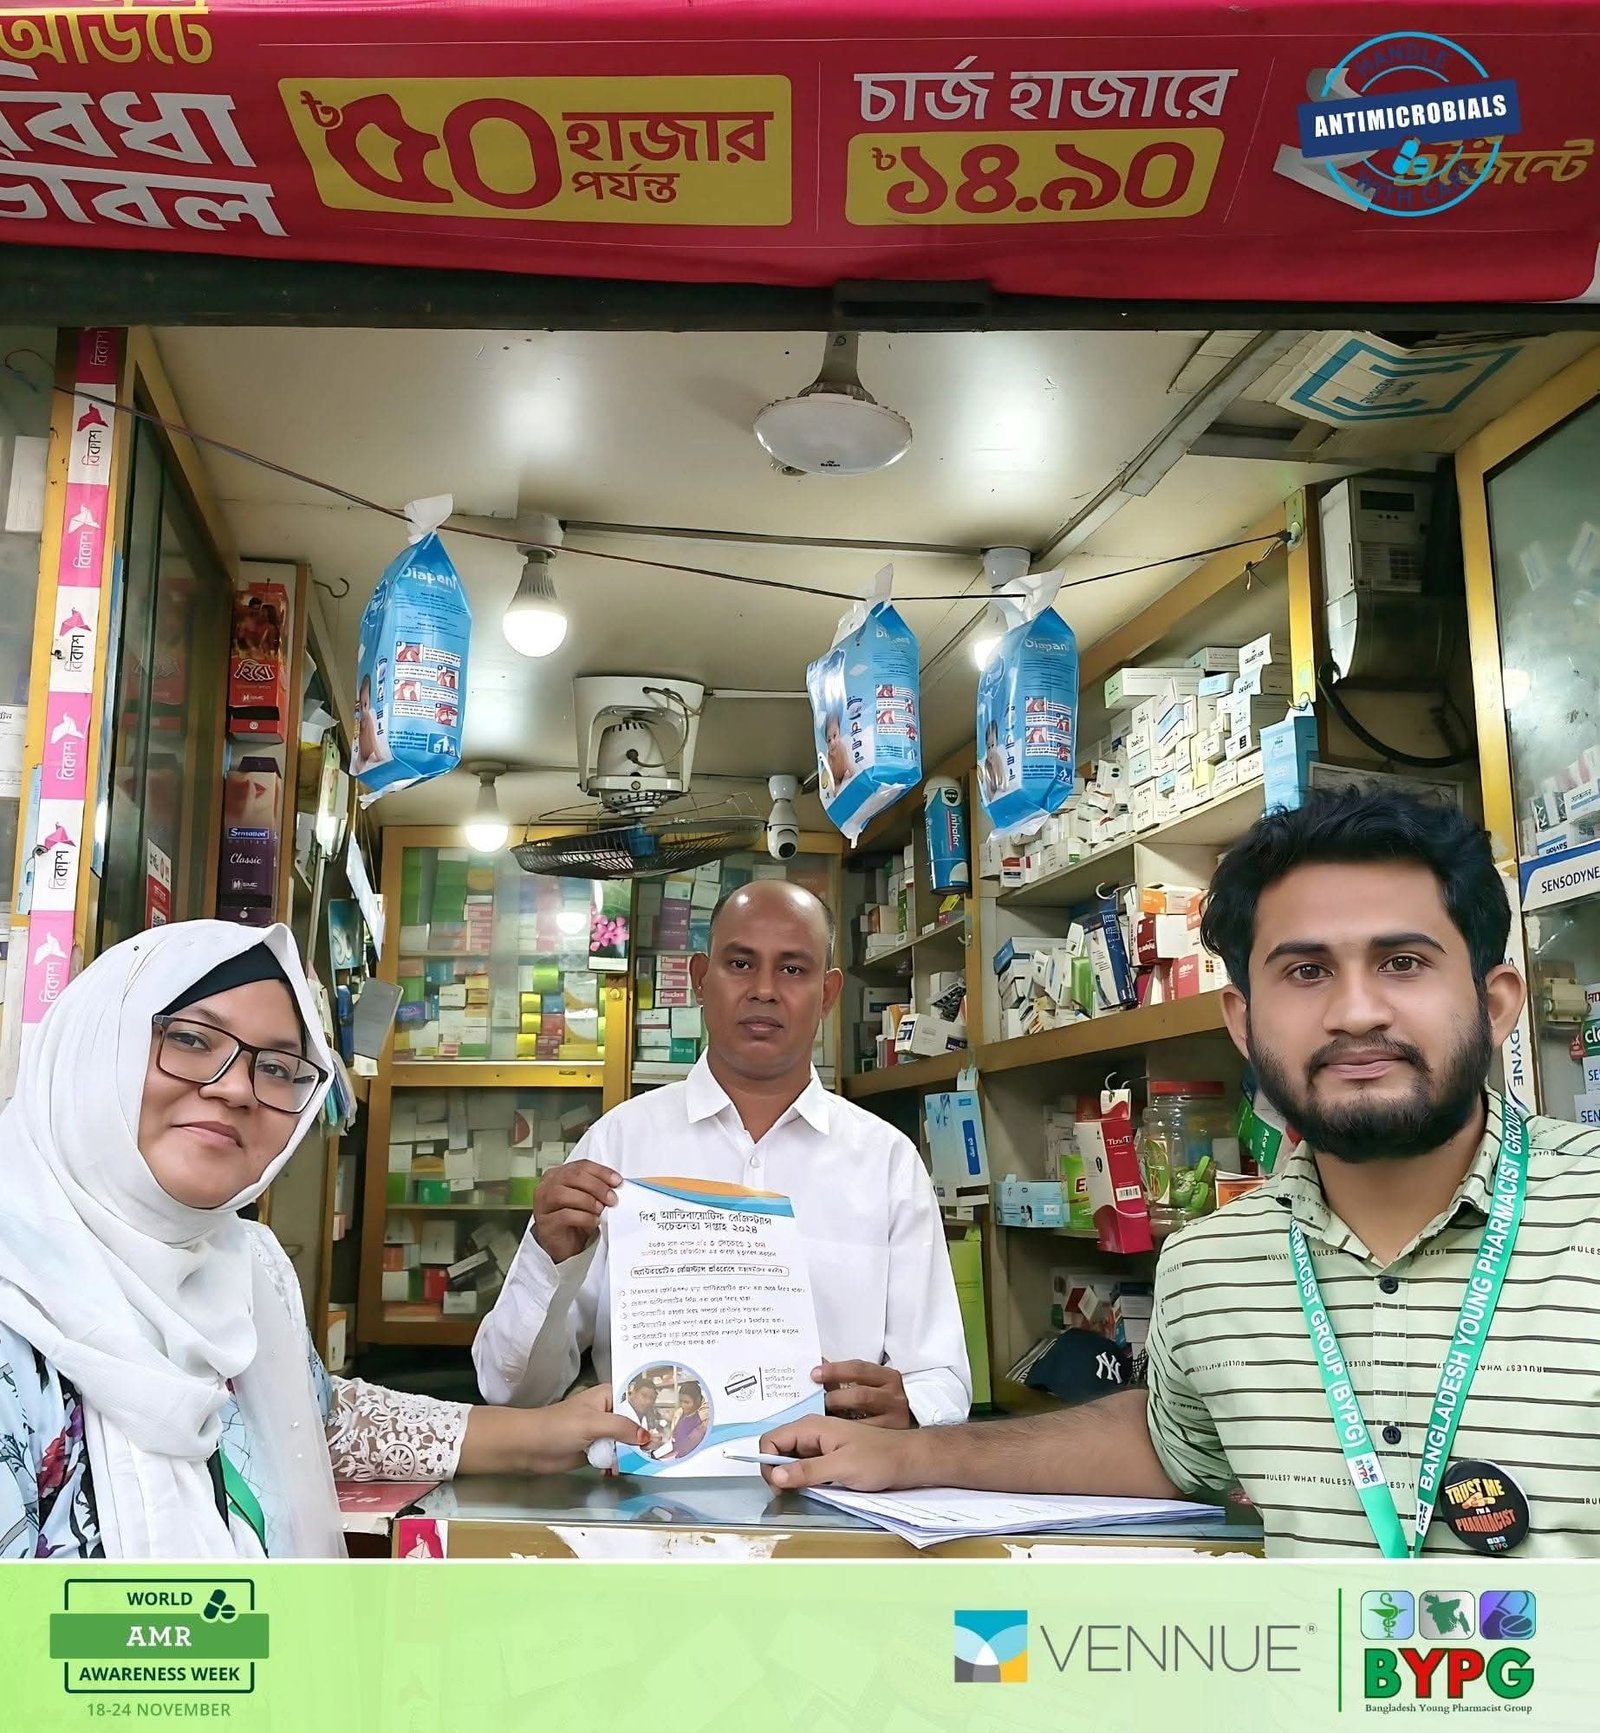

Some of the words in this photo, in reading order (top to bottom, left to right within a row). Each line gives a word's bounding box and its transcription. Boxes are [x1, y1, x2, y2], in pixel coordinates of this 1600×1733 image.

[853, 55, 994, 122] চার্জ
[1010, 68, 1239, 120] হাজারে
[0, 60, 256, 167] বিধা
[562, 111, 774, 165] হাজার
[573, 163, 680, 205] পর্যন্ত
[81, 430, 103, 466] বিকাশ
[72, 531, 93, 569] বিকাশ
[64, 634, 85, 673] বিকাশ
[56, 741, 77, 780] বিকাশ
[48, 850, 70, 890] বিকাশ
[229, 852, 263, 865] Classic
[1541, 865, 1600, 894] SENSODYNE
[639, 1211, 657, 1224] বিশ্ব
[656, 1221, 700, 1231] সচেতনতা
[704, 1221, 728, 1231] সপ্তাহ
[732, 1224, 758, 1235] ২০২৪
[1419, 1350, 1470, 1493] BANGLADESH
[1454, 1278, 1493, 1350] YOUNG
[1477, 1154, 1521, 1275] PHARMACIST
[1505, 1102, 1522, 1155] GROUP
[1310, 1309, 1345, 1374] GROUP
[1326, 1378, 1367, 1449] (BYPG)
[1293, 1475, 1317, 1483] WHAT
[1444, 1478, 1483, 1505] TRUST
[1482, 1478, 1505, 1497] ME
[1455, 1509, 1516, 1532] PHARMACIST
